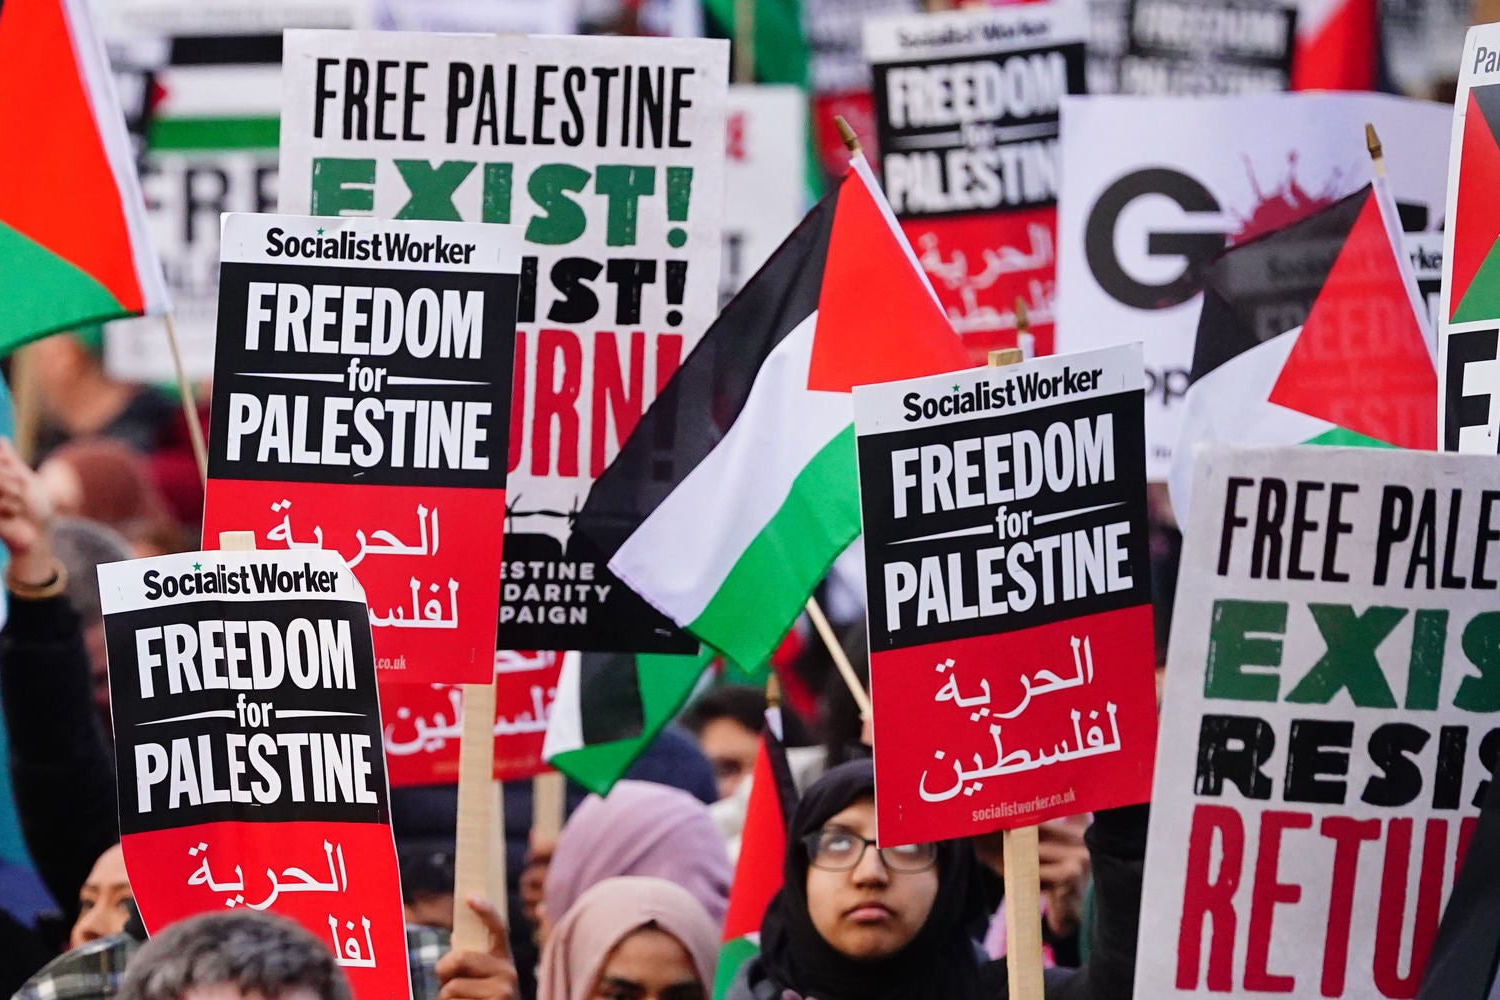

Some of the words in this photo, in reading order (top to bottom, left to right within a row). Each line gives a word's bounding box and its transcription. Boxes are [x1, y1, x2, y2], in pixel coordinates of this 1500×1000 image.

[313, 57, 429, 142] FREE
[445, 61, 696, 149] PALESTINE
[885, 51, 1068, 129] FREEDOM
[310, 156, 695, 250] EXIST!
[883, 138, 1057, 214] PALESTIN
[244, 281, 485, 360] FREEDOM
[516, 255, 689, 327] IST!
[346, 357, 388, 393] for
[226, 392, 493, 472] PALESTINE
[890, 412, 1116, 519] FREEDOM
[994, 504, 1033, 541] for
[1215, 476, 1360, 584] FREE
[883, 520, 1135, 633] PALESTINE
[134, 616, 358, 700] FREEDOM
[933, 634, 1095, 723] الحرية
[235, 693, 275, 730] for
[917, 699, 1123, 804] لفلسطين
[133, 732, 380, 815] PALESTINE
[971, 786, 1077, 823] socialistworker.co.uk
[186, 837, 349, 912] الحرية
